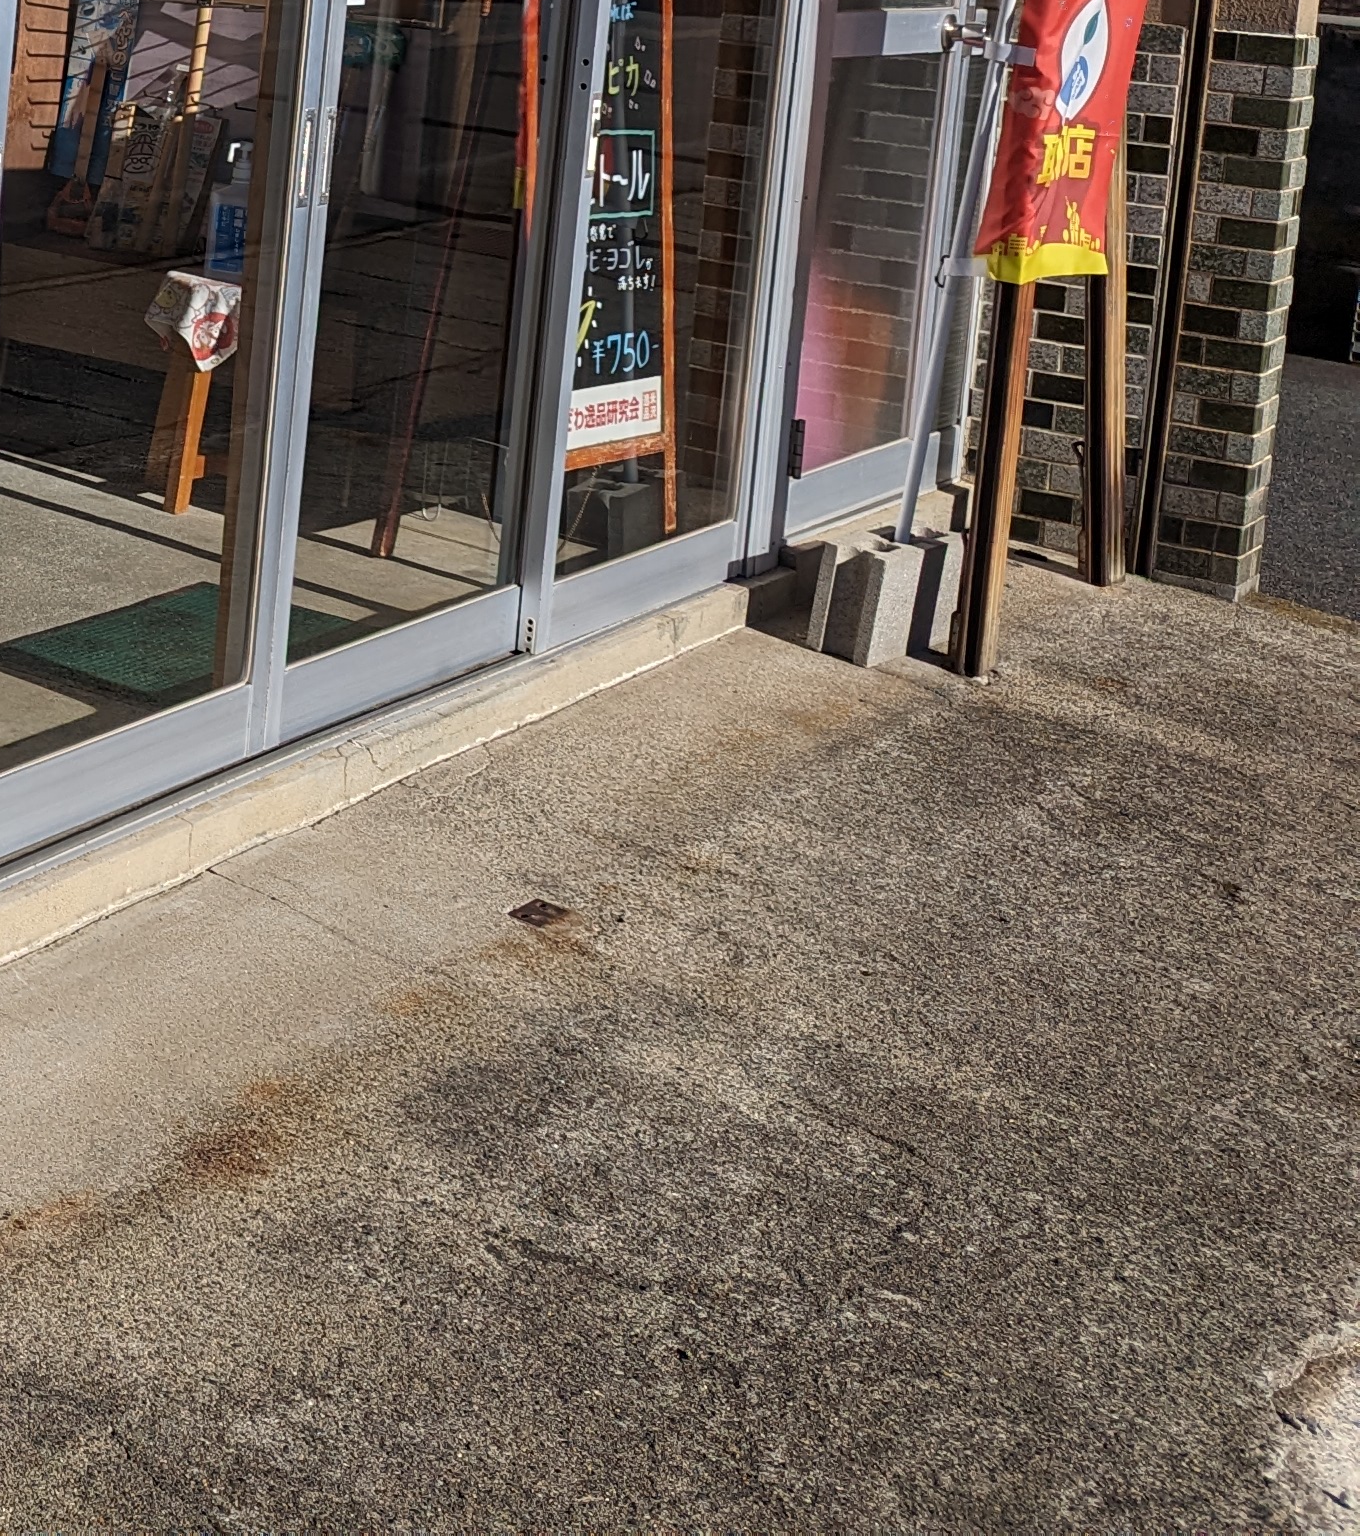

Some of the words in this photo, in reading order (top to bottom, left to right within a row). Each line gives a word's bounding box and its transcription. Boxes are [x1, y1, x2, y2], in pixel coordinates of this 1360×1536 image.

[589, 149, 651, 207] トール
[1036, 124, 1096, 188] 取店
[586, 222, 617, 243] 感覚で
